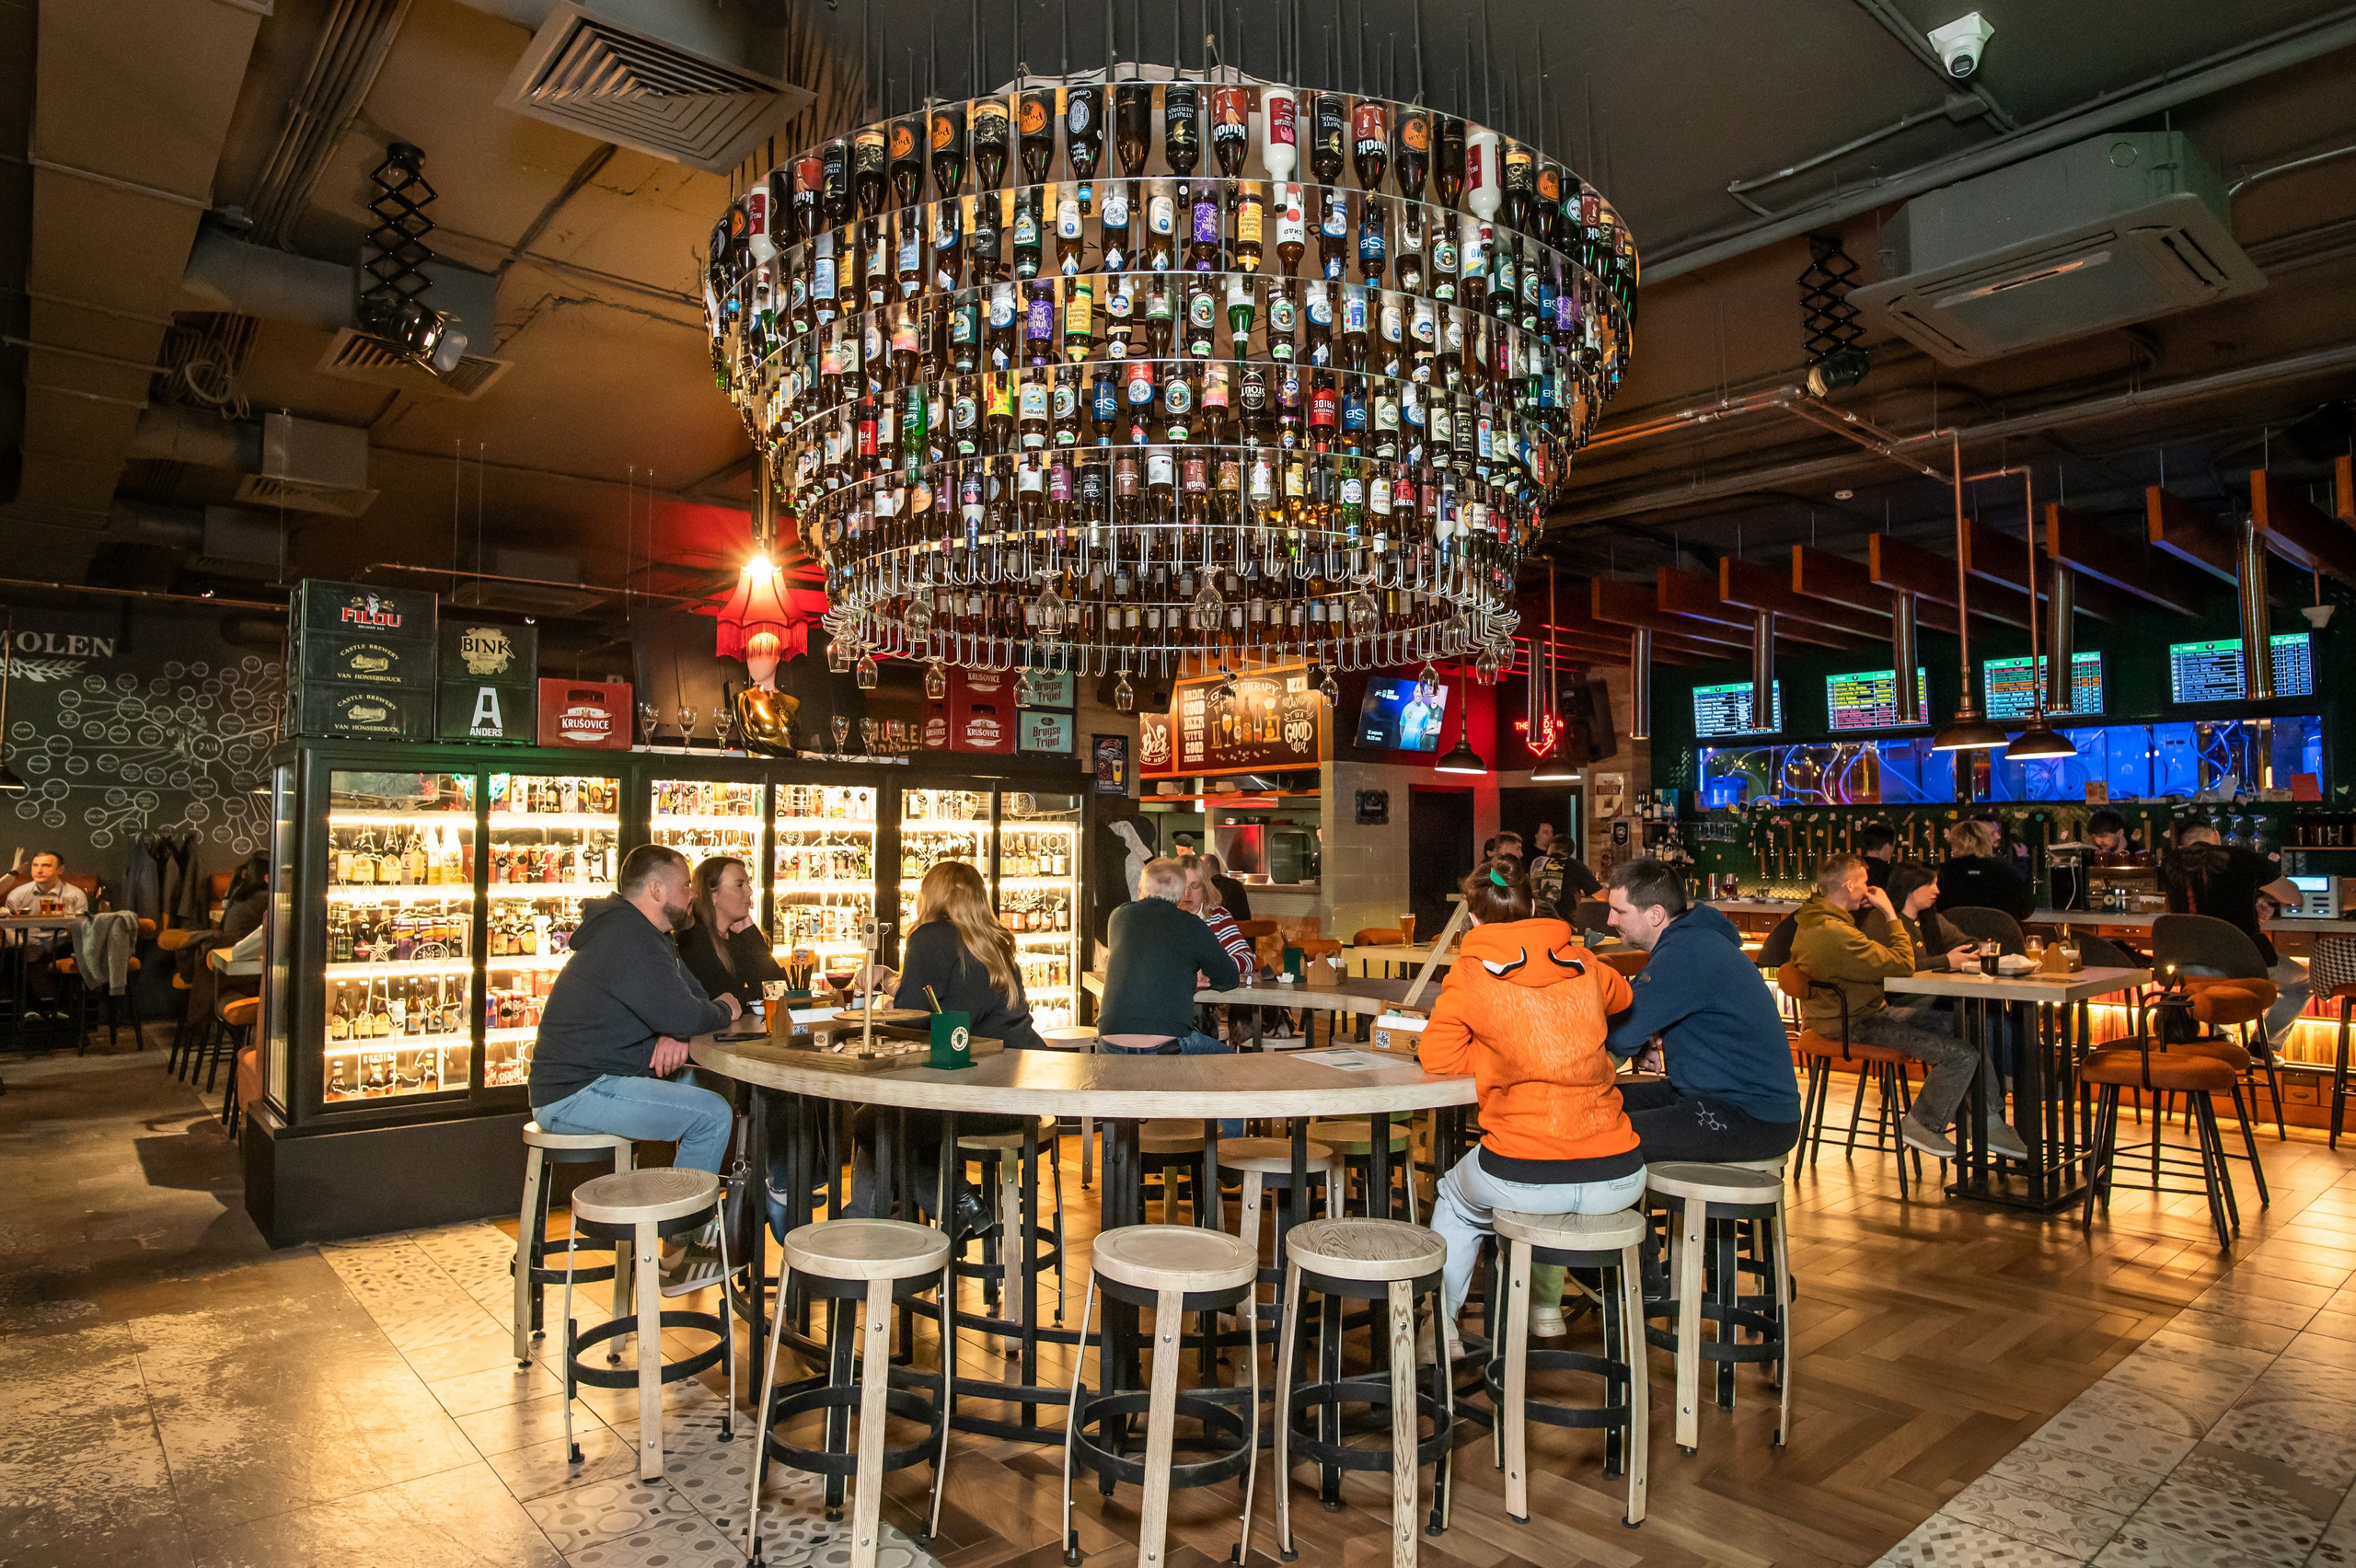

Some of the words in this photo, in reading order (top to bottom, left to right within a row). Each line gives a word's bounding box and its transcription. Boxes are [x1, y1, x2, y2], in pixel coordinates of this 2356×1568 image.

[1166, 107, 1194, 115] HENDRIK
[1168, 111, 1193, 120] STRAFFE
[1240, 386, 1265, 398] STOUT
[1313, 399, 1335, 409] PRIDE
[1024, 408, 1045, 416] Ayinger
[1345, 409, 1367, 421] SB
[341, 606, 402, 628] FILOU
[340, 644, 365, 656] CASTLE
[369, 644, 399, 661] BREWERY
[462, 637, 514, 658] BINK
[354, 674, 401, 683] HONSEBROUCK
[967, 672, 1000, 684] KRUŠOVICE
[1034, 680, 1063, 691] Brugse
[1240, 681, 1279, 696] THERAPY
[1037, 689, 1061, 702] Tripel
[1184, 688, 1205, 700] DRINK
[337, 694, 363, 707] CASTLE
[366, 694, 398, 710] BREWERY
[1184, 700, 1205, 716] GOOD
[351, 724, 399, 733] HONSEBROUCK
[561, 717, 609, 730] KRUŠOVICE
[1184, 715, 1205, 730] BEER
[1515, 721, 1529, 730] THE
[469, 727, 503, 737] ANDERS
[966, 727, 999, 738] KRUŠOVICE
[1033, 726, 1061, 737] Brugse
[1184, 730, 1204, 742] WITH
[1285, 721, 1313, 744] GOOD
[1035, 736, 1059, 748] Tripel
[1142, 733, 1167, 755] Beer
[1184, 741, 1205, 755] GOOD
[1290, 739, 1309, 754] idea
